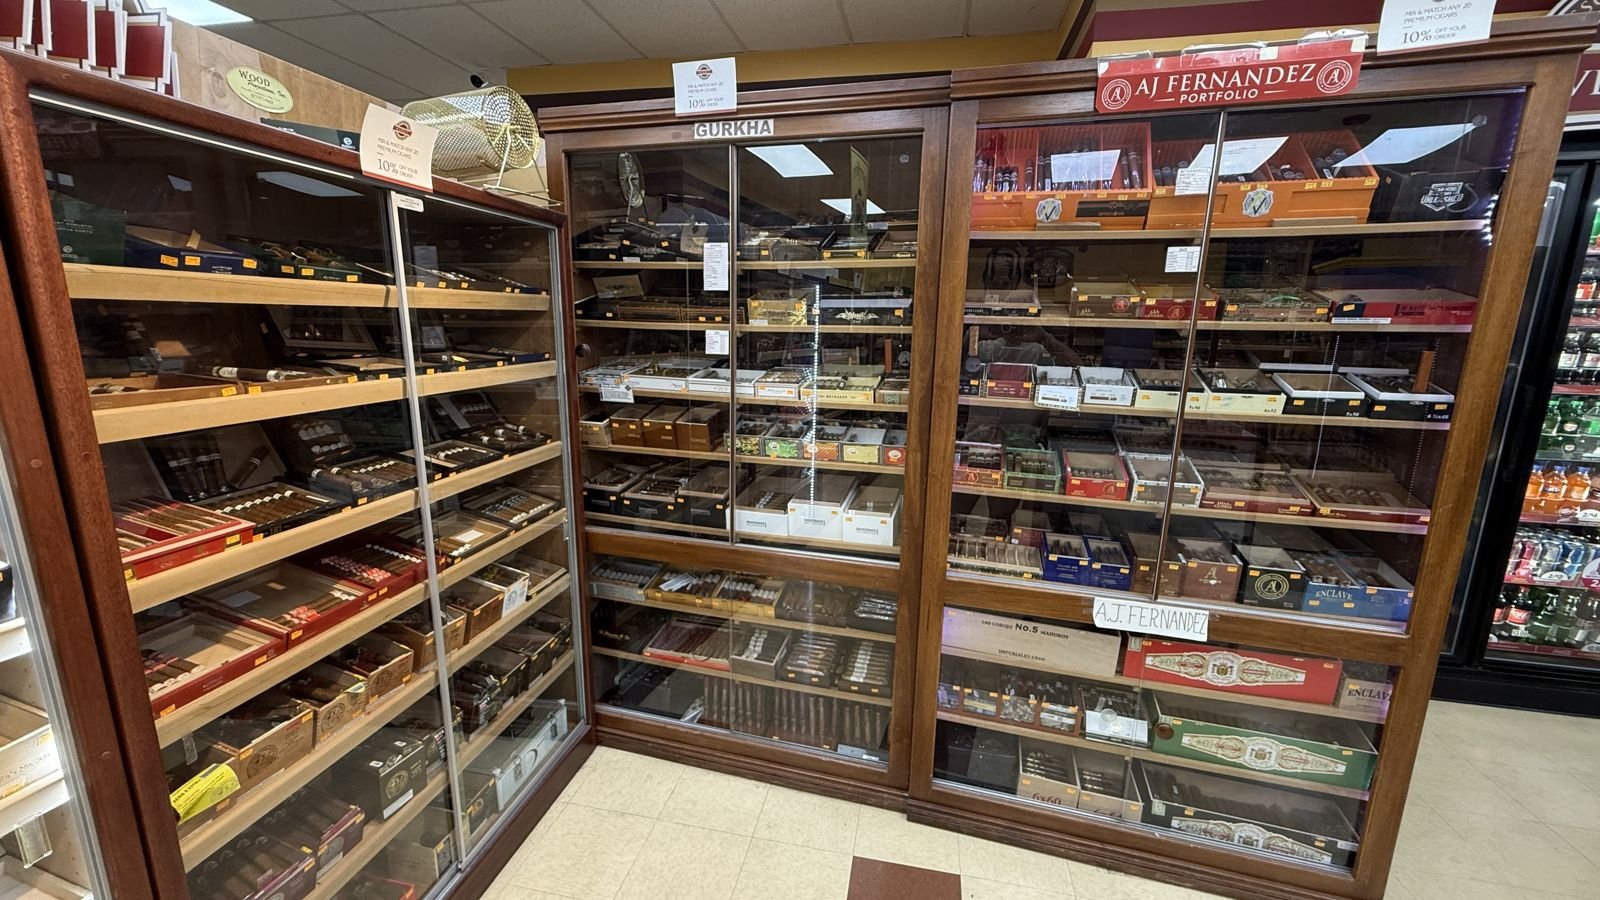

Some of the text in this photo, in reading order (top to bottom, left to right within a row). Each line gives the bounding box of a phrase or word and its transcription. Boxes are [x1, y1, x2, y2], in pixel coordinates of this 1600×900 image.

[1424, 6, 1446, 14] MATCH
[1404, 15, 1432, 24] PREMIUM
[1403, 29, 1432, 44] 10%
[239, 70, 270, 86] WOOD
[1134, 64, 1316, 99] AJ FERNANDEZ
[1180, 89, 1258, 104] PORTFOLIO
[689, 99, 705, 108] 10%
[696, 120, 771, 137] GURKHA
[377, 144, 412, 159] PREMIUM CIGARS
[390, 142, 404, 150] MATCH
[378, 159, 398, 174] 10%
[407, 166, 418, 174] YOUR
[1421, 194, 1464, 204] UNLESHED
[1316, 590, 1352, 600] ENCLAVE
[1095, 602, 1208, 635] A.J. FERNANDEZ
[992, 621, 1012, 629] COROJO
[1015, 623, 1038, 633] No.5
[1040, 631, 1068, 639] MADUROS
[998, 649, 1030, 659] IMPERIALES
[1348, 688, 1389, 700] ENCLAV
